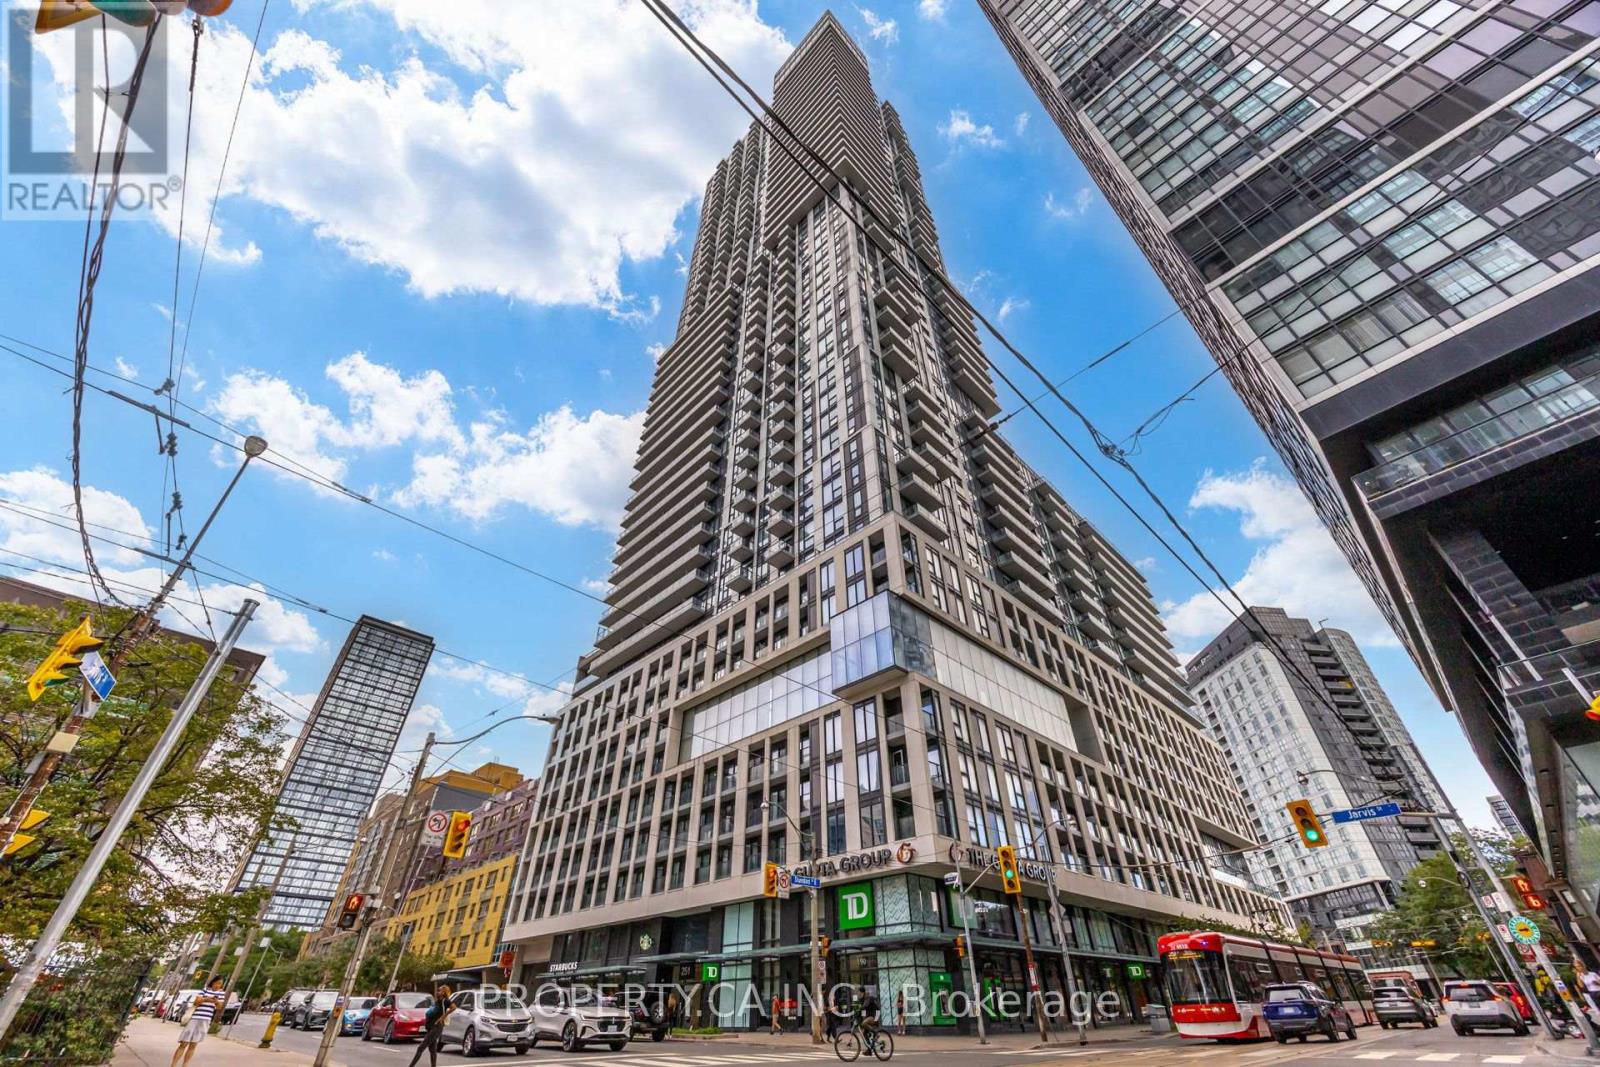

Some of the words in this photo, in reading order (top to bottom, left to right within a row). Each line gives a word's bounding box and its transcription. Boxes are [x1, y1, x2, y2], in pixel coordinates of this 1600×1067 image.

[1347, 807, 1377, 820] Jarvis
[794, 861, 837, 876] GUTA
[840, 849, 891, 872] GROUP
[842, 892, 869, 920] TD
[549, 961, 578, 973] STARBUCKS
[706, 966, 718, 978] TD
[1128, 966, 1142, 977] TD
